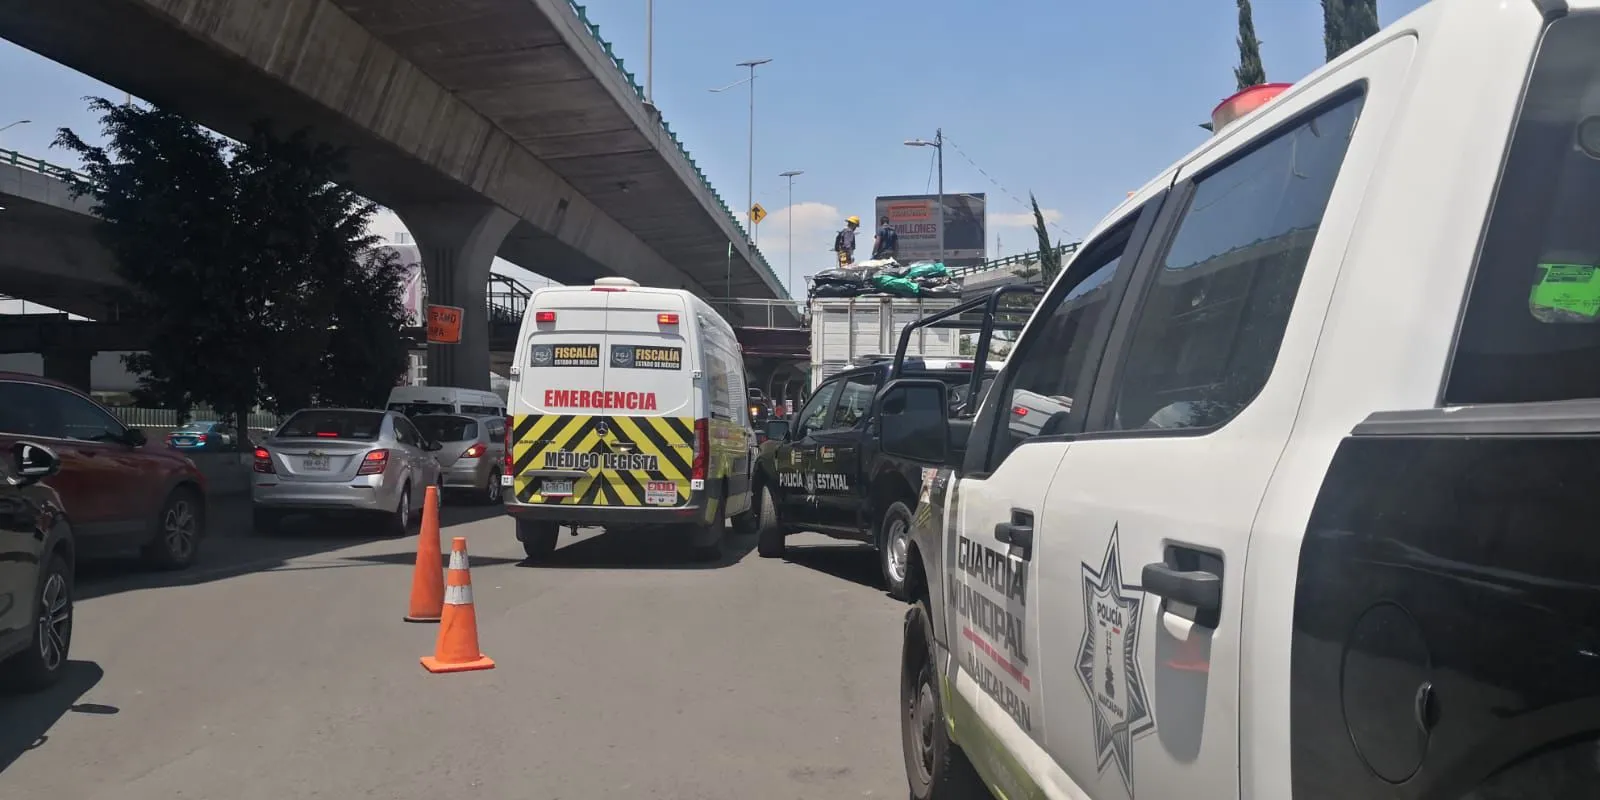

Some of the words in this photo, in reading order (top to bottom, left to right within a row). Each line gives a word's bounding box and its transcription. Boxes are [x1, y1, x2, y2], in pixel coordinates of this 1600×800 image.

[554, 346, 598, 359] FISCALÍA
[635, 348, 680, 361] FISCALÍA
[544, 389, 657, 411] EMERGENCIA
[544, 448, 599, 470] MÉDICO
[602, 453, 659, 471] LEGISTA
[648, 482, 676, 491] 911
[779, 468, 804, 488] POLICÍA
[817, 473, 849, 490] ESTATAL
[958, 535, 1026, 607] GUARDIA
[949, 573, 1029, 665] MUNICIPAL
[1097, 601, 1122, 628] POLICÍA
[968, 651, 1031, 731] NAUCALPAN
